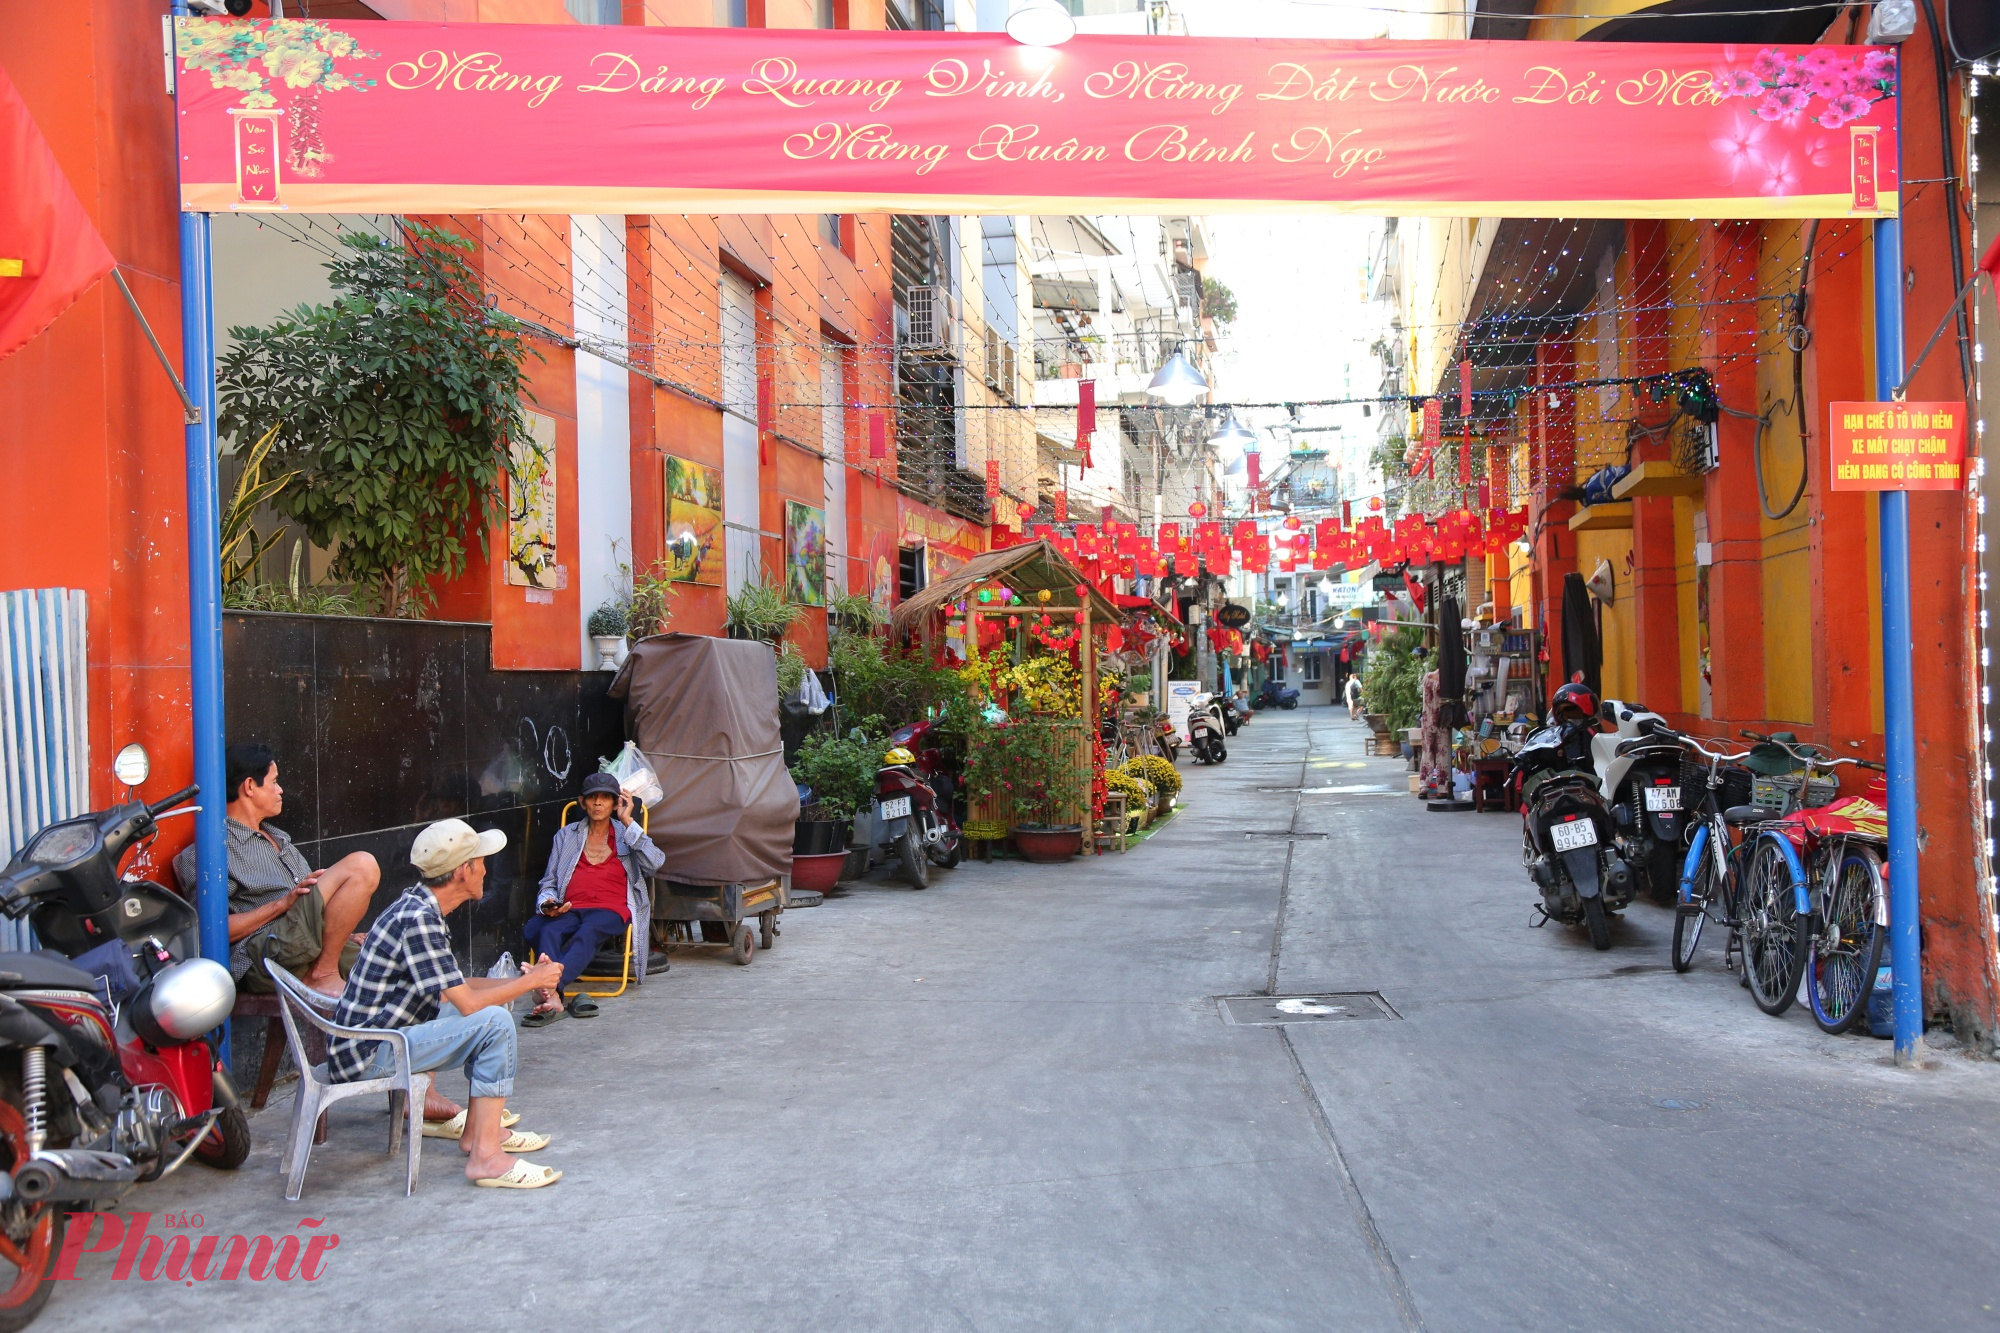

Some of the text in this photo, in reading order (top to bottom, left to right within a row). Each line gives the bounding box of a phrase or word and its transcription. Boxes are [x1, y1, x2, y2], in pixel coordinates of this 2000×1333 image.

[386, 50, 563, 108] Mừng
[577, 52, 726, 110] Đảng
[741, 57, 902, 112] Quang
[1083, 61, 1244, 115] Mừng
[1256, 63, 1361, 104] Đất
[1369, 65, 1501, 105] Nước
[1511, 66, 1605, 105] Đổi
[783, 122, 1386, 179] Mừng Xuân Bính Ngọ
[1843, 409, 1953, 432] HẠN CHẾ Ô TÔ VÀO HẺM
[1852, 435, 1946, 456] XE MÁY CHẠY CHẬM
[1837, 459, 1960, 479] HẺM ĐANG CÓ CÔNG TRÌNH
[1651, 789, 1677, 799] 47-AM
[1558, 821, 1587, 838] 60-B5
[1557, 832, 1594, 850] 994.33
